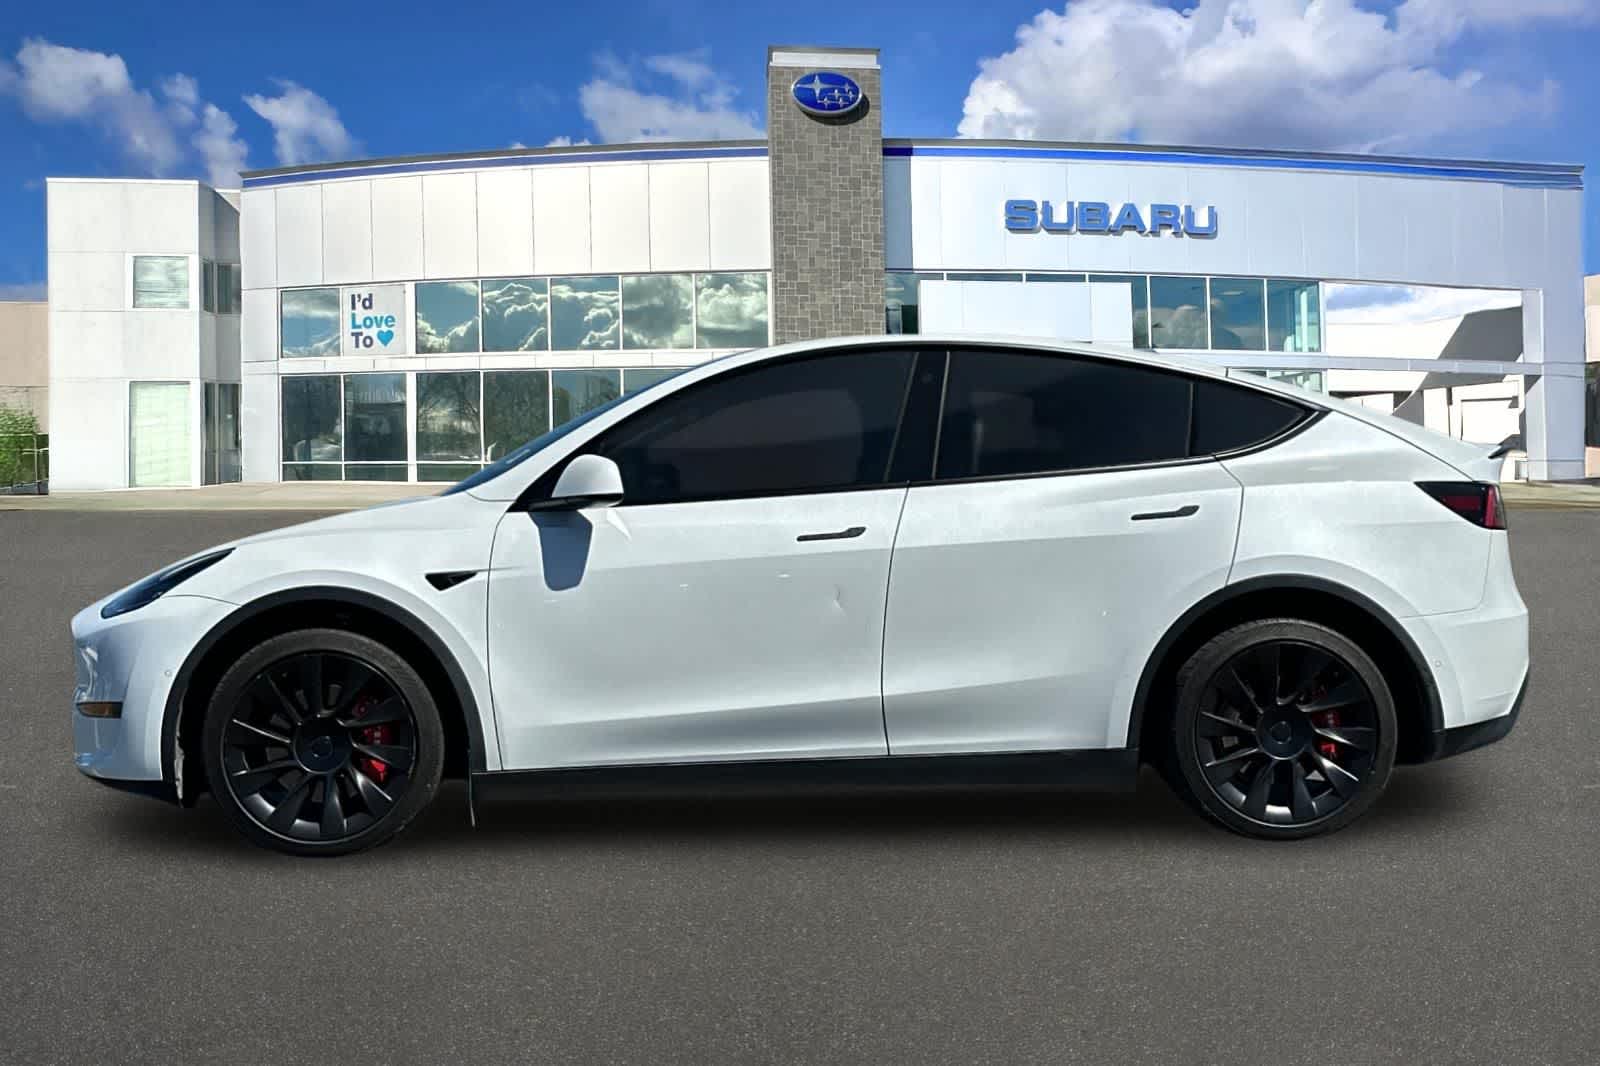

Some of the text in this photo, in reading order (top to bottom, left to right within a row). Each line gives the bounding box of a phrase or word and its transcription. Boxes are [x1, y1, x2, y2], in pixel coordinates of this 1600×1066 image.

[1005, 199, 1217, 236] SUBARU
[350, 293, 373, 310] I'd
[351, 312, 396, 329] Love
[350, 331, 374, 348] To
